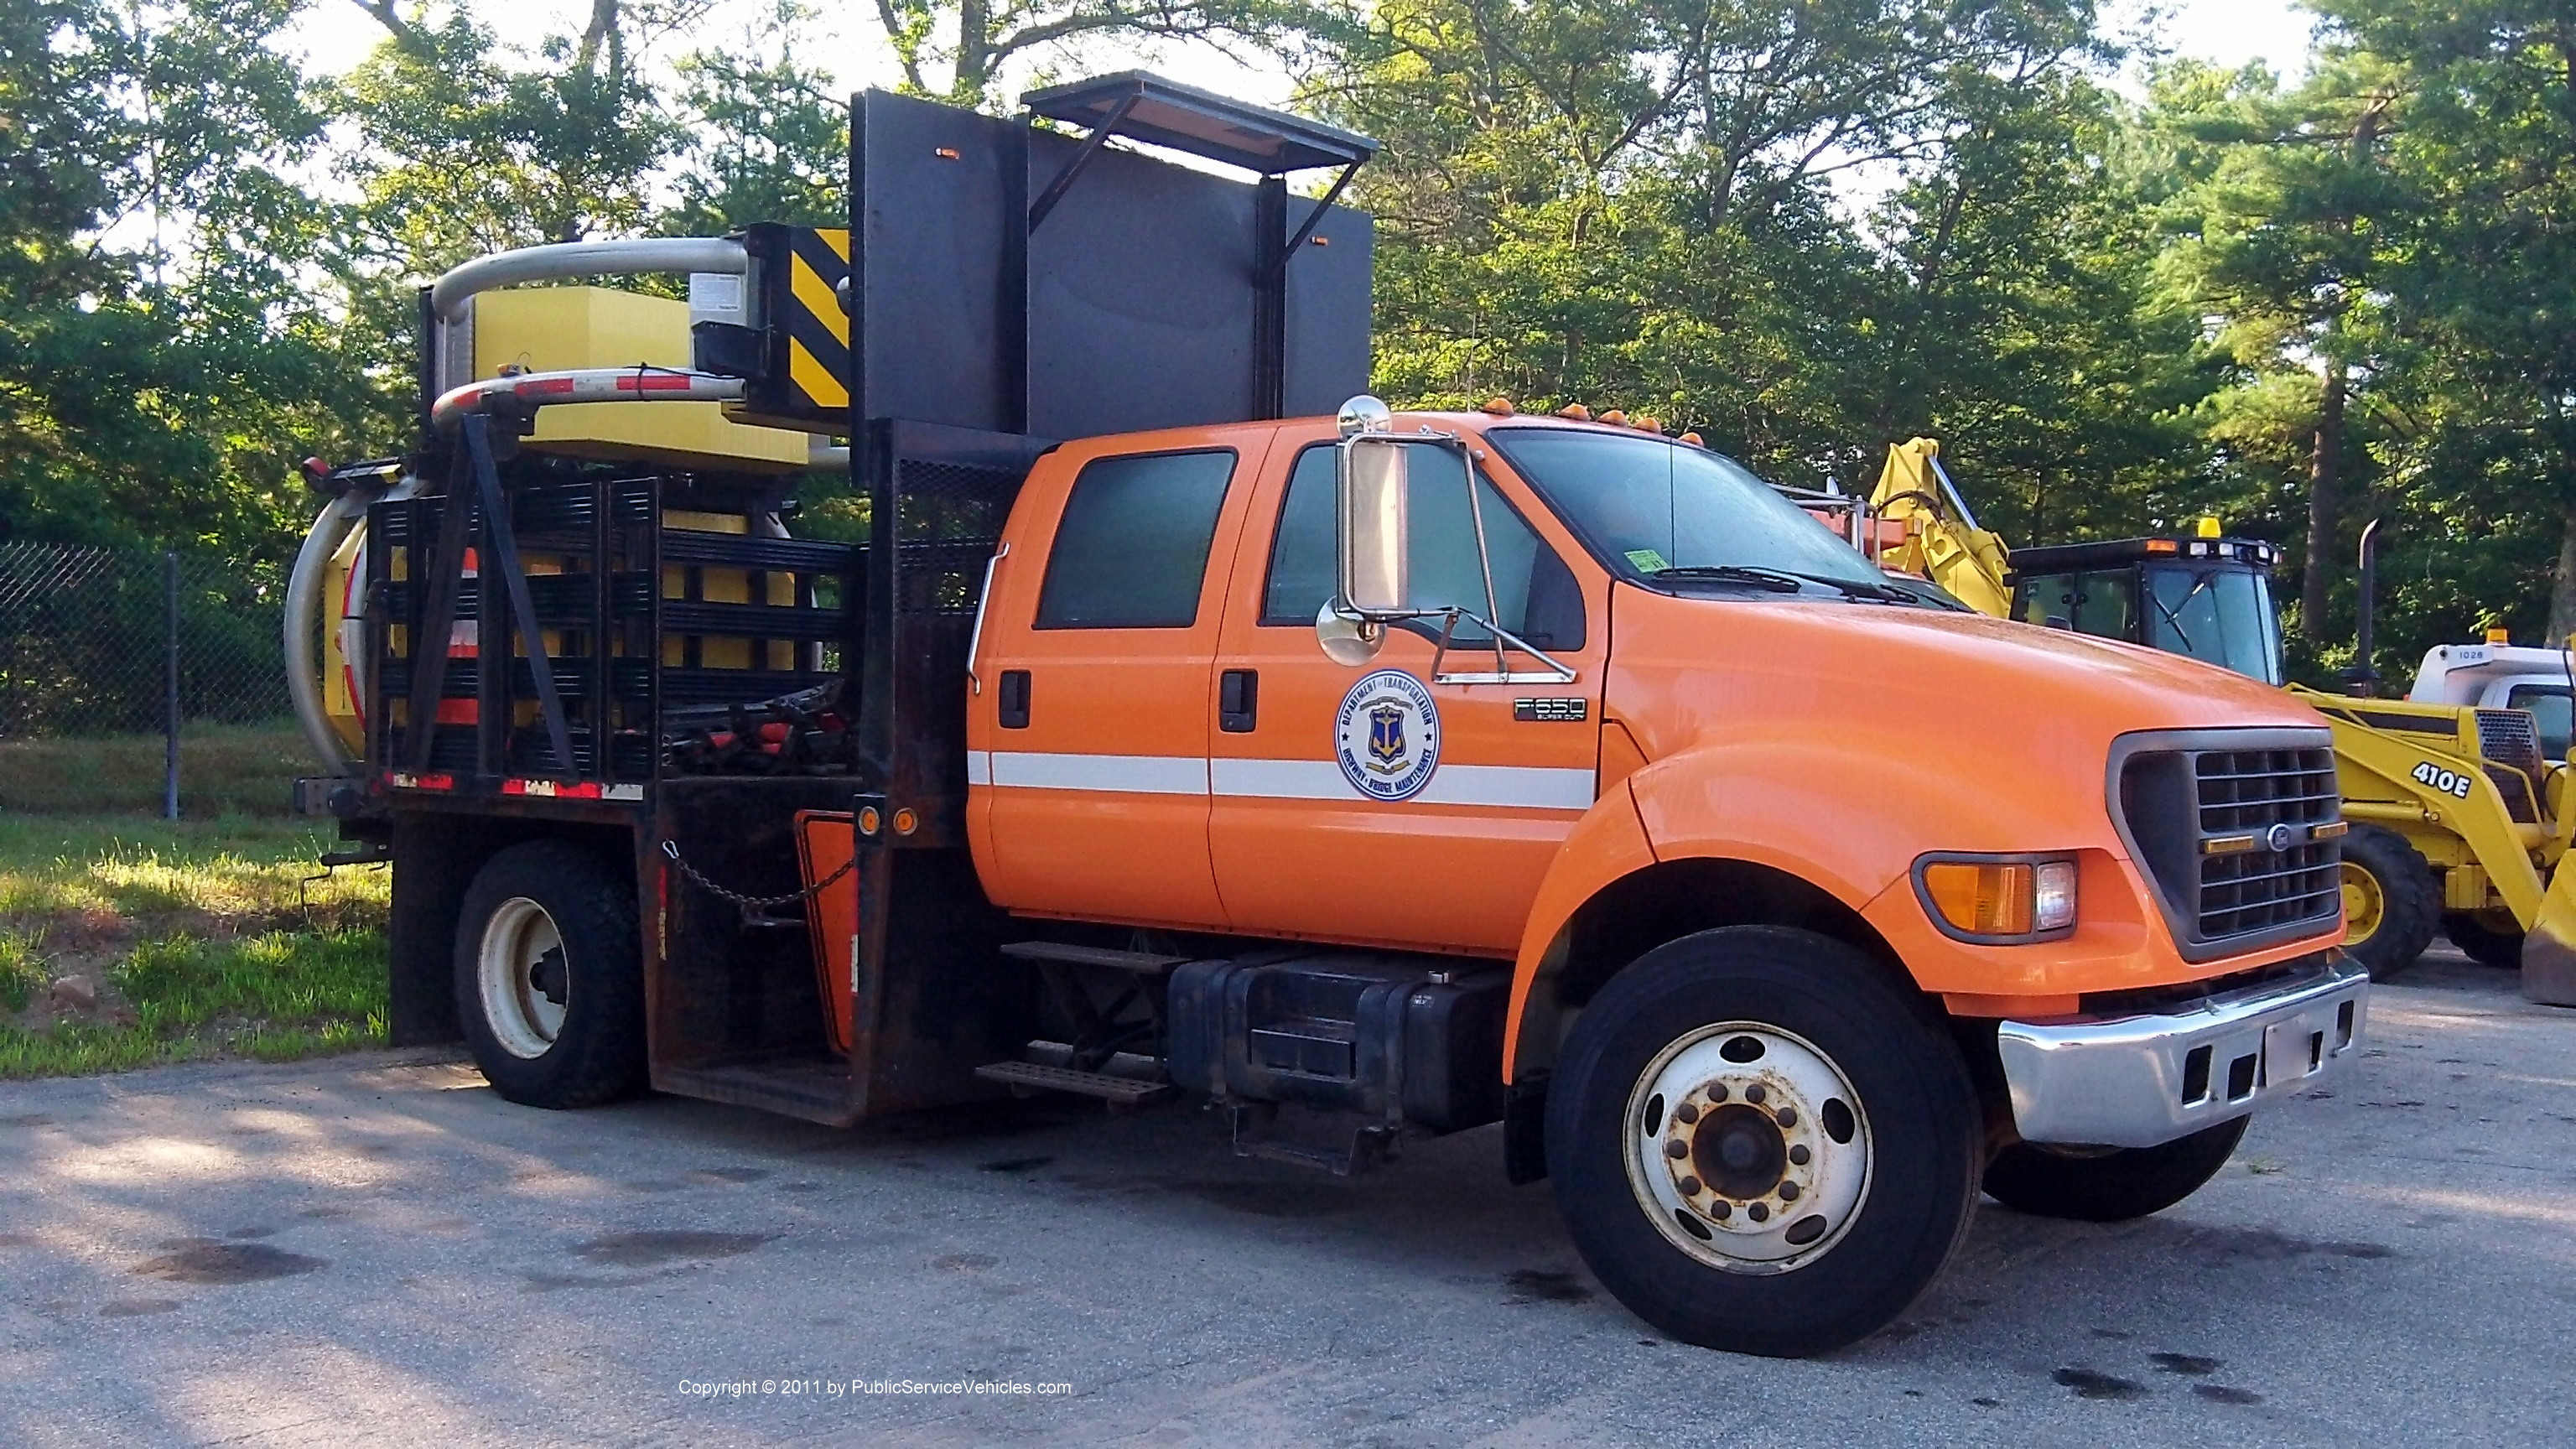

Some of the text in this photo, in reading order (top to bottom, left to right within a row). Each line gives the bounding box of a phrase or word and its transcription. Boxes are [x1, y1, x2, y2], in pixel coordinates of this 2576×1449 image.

[1342, 678, 1433, 726] DEPARTMENT TRANSPORTATION
[2412, 762, 2470, 798] 410E
